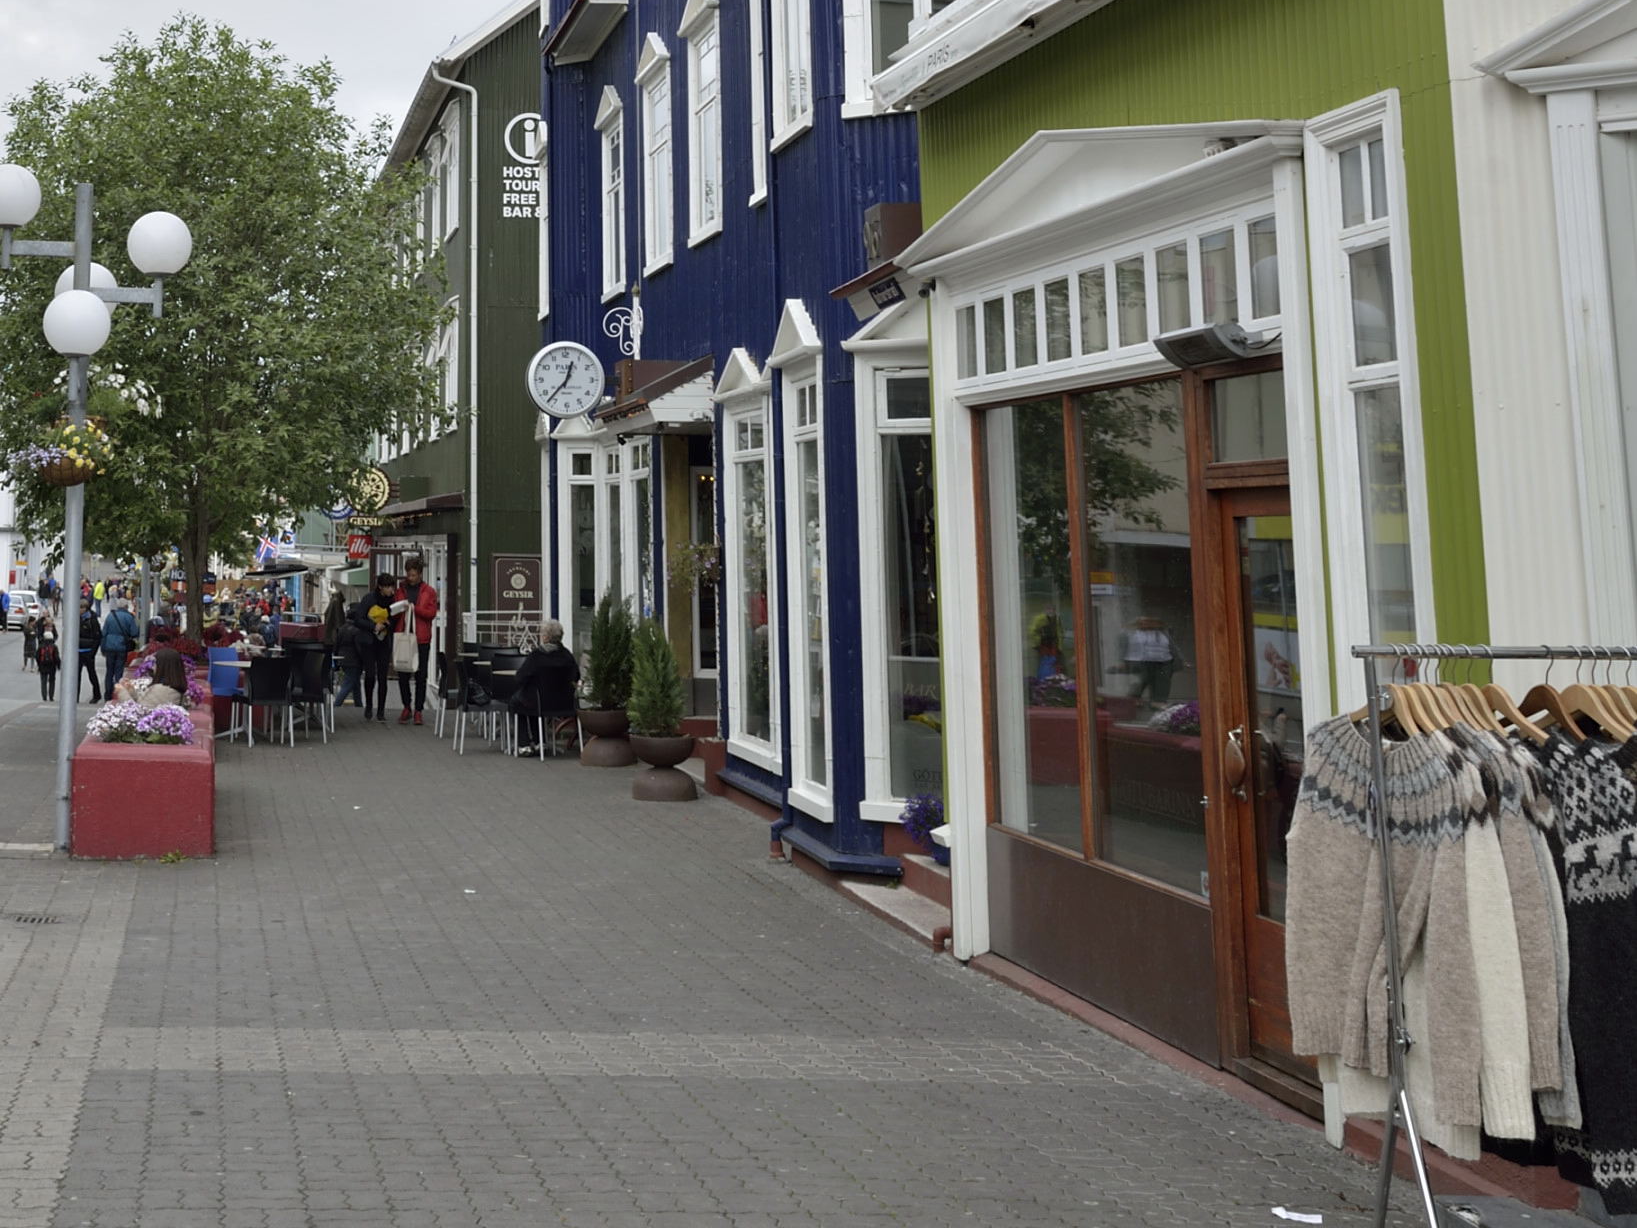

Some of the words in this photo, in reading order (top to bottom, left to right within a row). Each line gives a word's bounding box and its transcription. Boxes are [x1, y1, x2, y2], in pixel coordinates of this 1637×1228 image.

[503, 193, 537, 205] FREE
[503, 206, 532, 218] BAR
[350, 538, 372, 557] illy
[503, 590, 534, 599] GEYSIR
